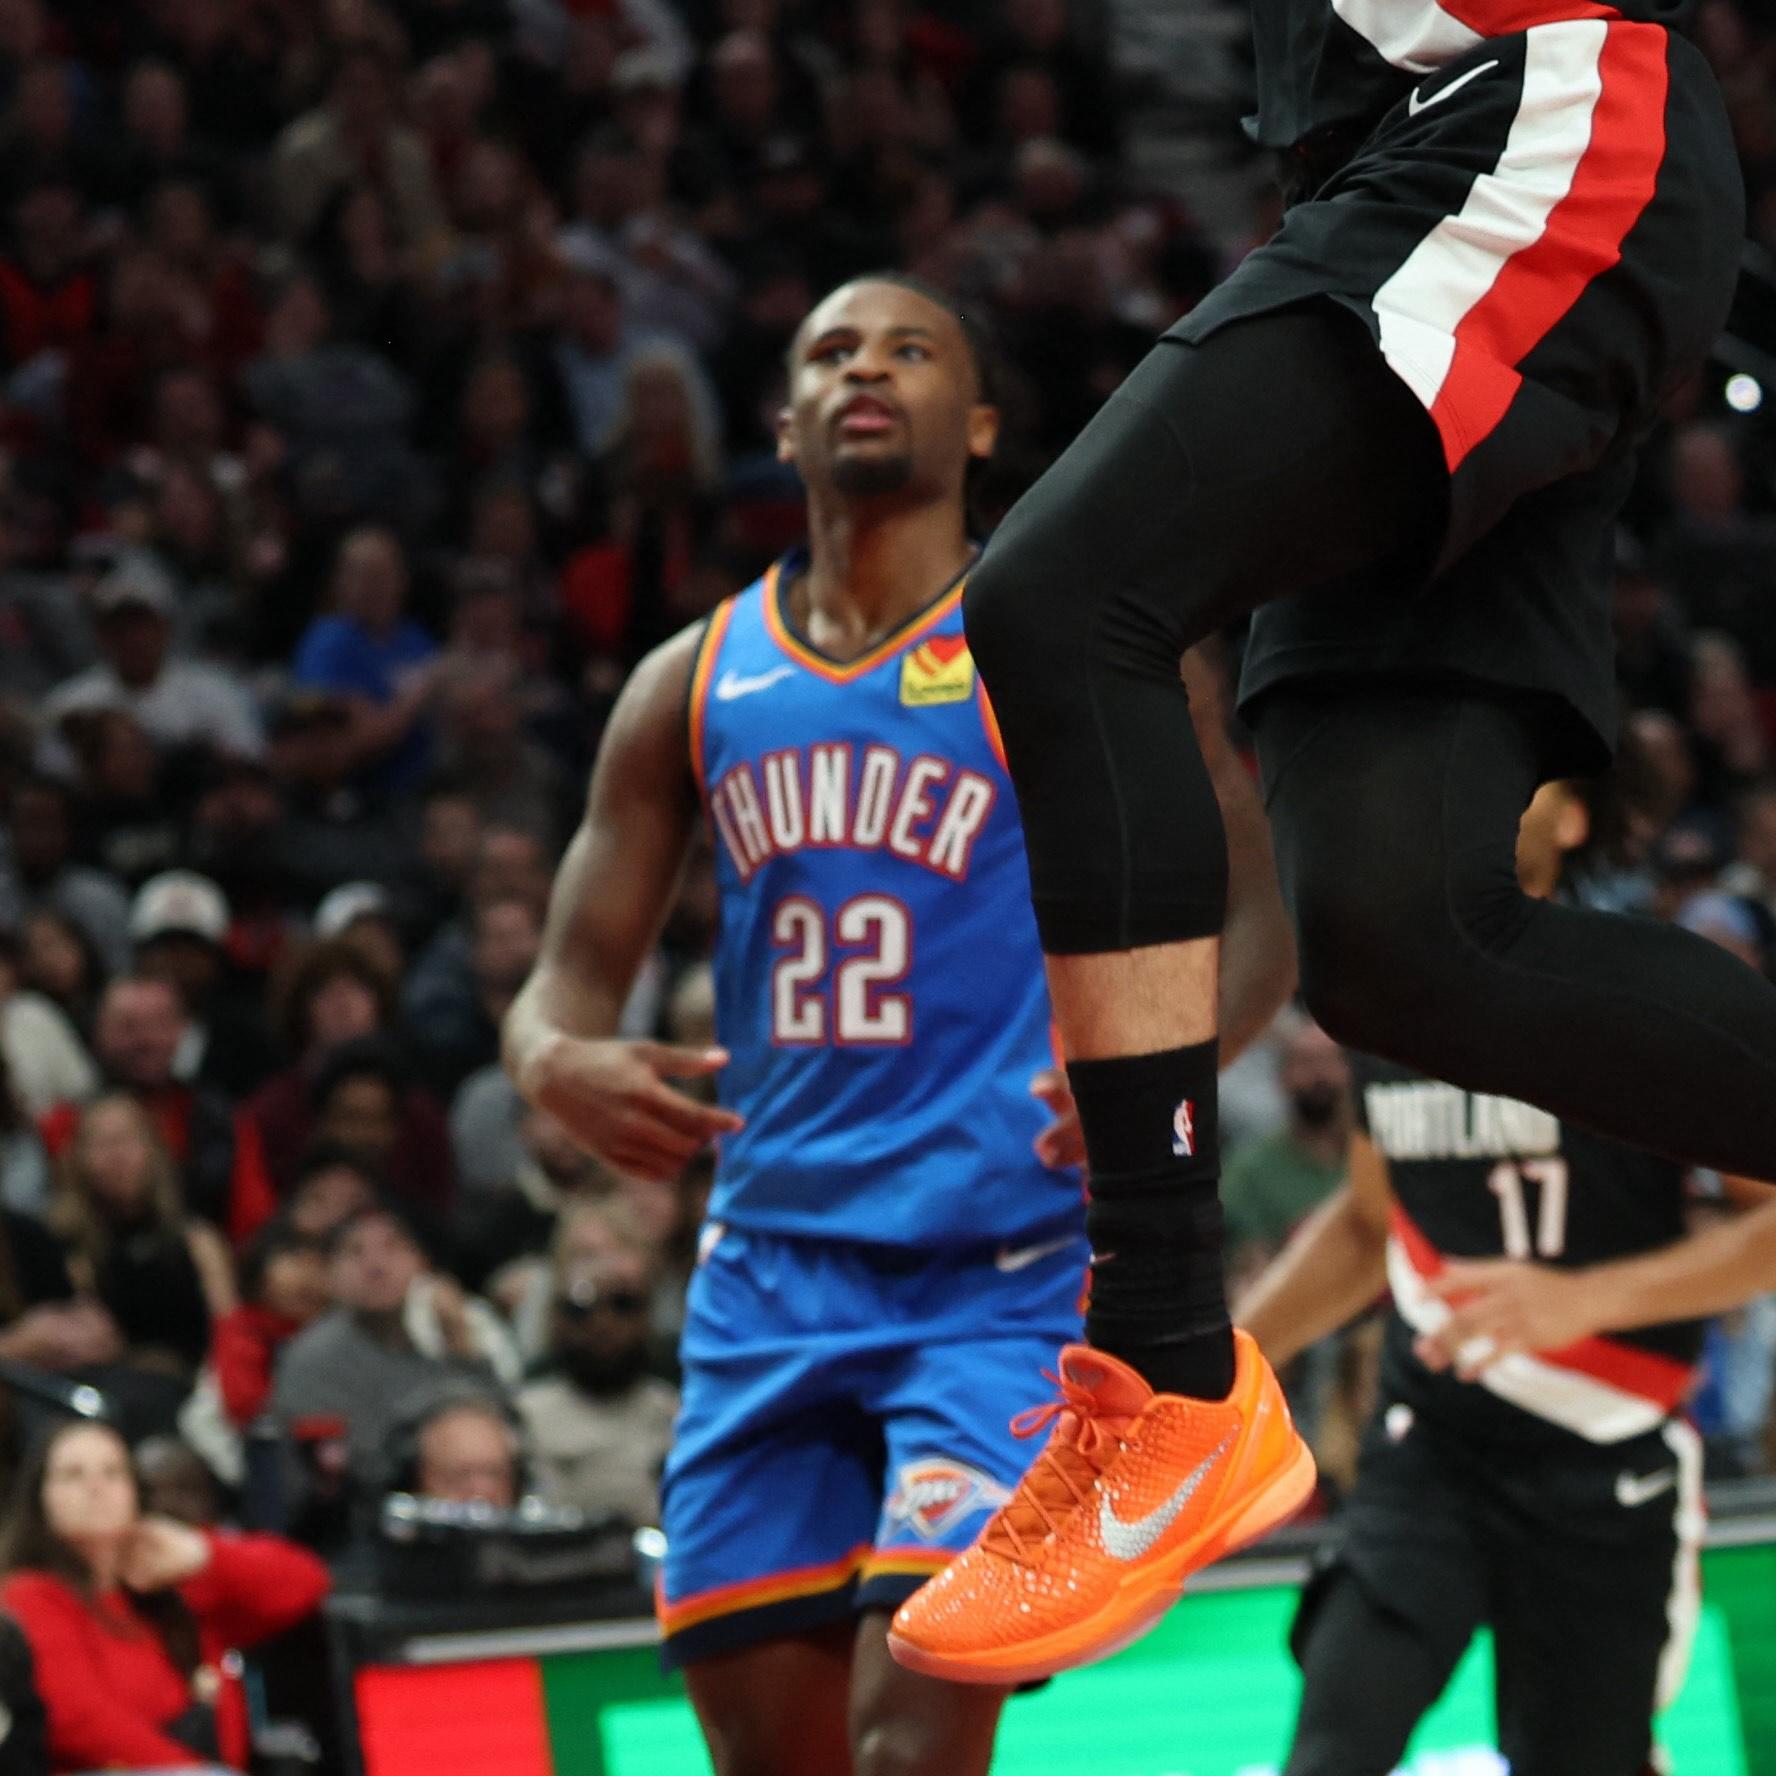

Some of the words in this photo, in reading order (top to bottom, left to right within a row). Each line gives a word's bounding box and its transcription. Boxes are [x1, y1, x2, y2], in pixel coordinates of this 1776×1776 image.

[711, 738, 998, 885] THUNDER
[771, 893, 914, 1048] 22
[1488, 1159, 1570, 1261] 17
